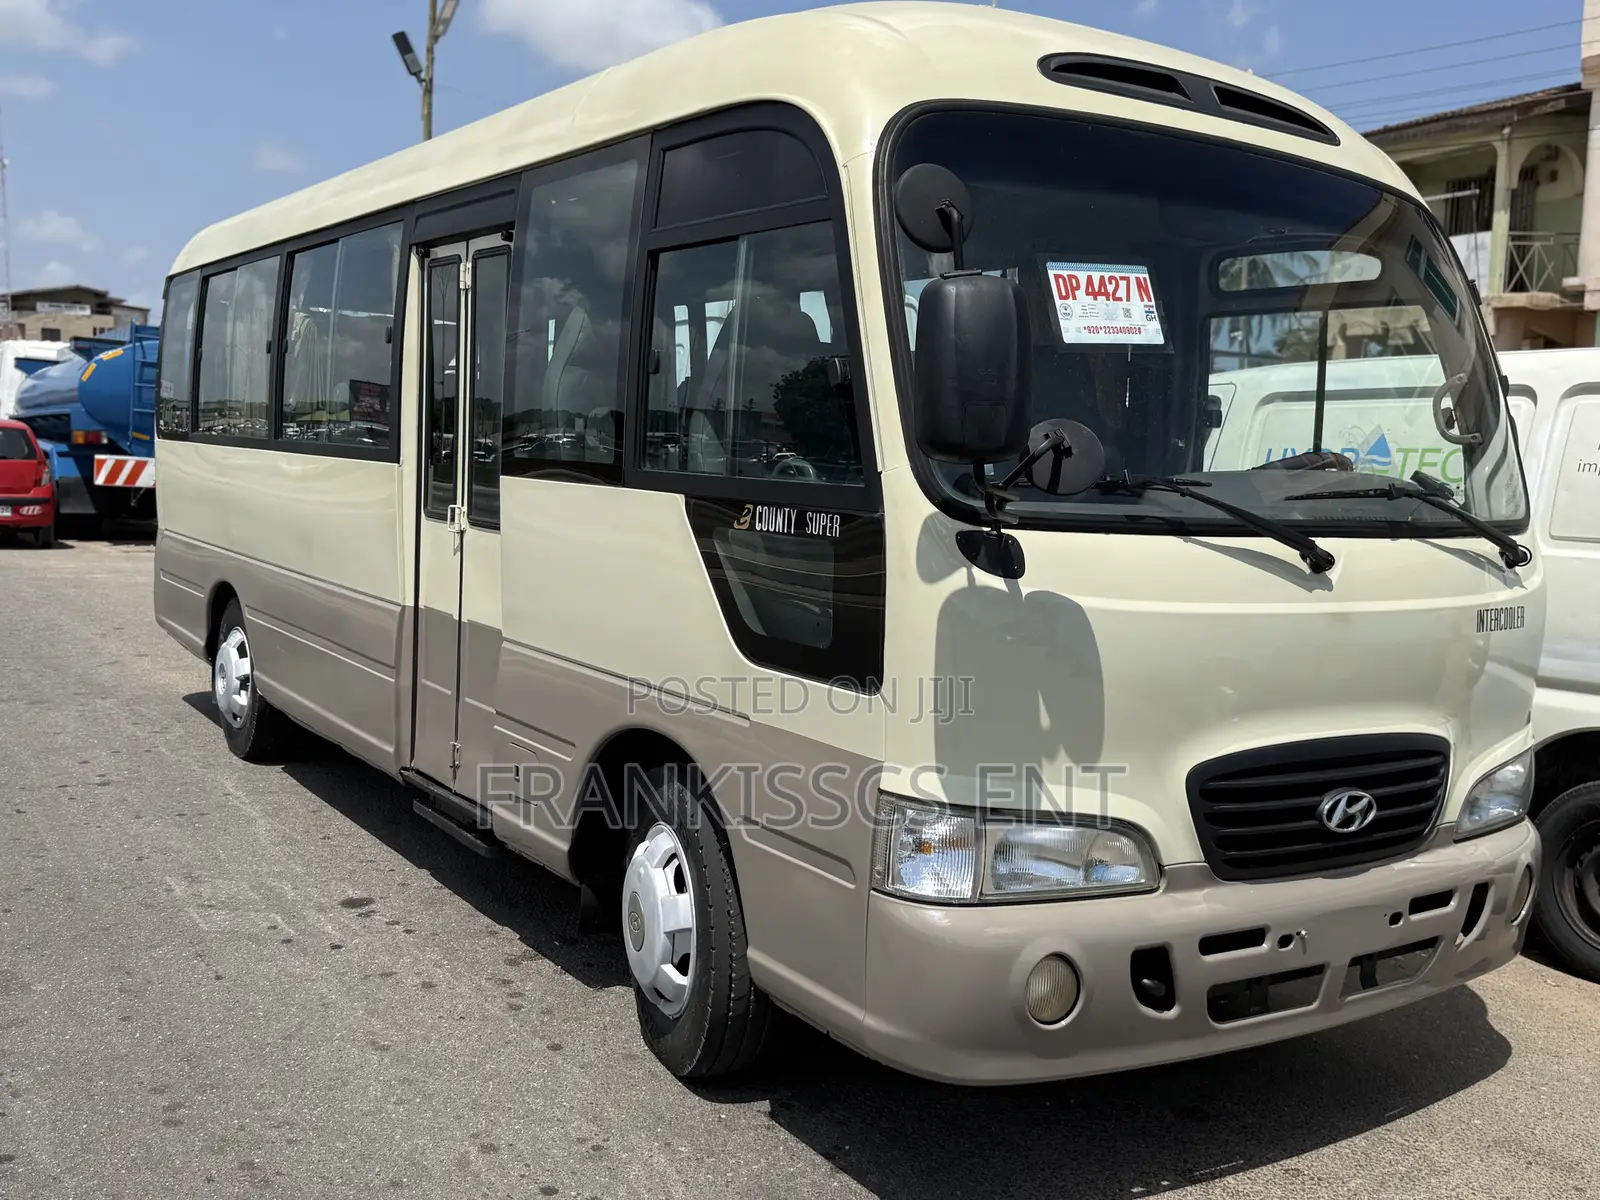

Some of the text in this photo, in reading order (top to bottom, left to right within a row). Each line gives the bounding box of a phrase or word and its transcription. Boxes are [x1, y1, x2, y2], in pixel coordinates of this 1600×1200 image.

[1053, 273, 1153, 303] DP 4427 N
[1145, 314, 1157, 322] GH
[755, 505, 841, 538] COUNTY SUPER
[1476, 606, 1525, 633] INTERCOOLER
